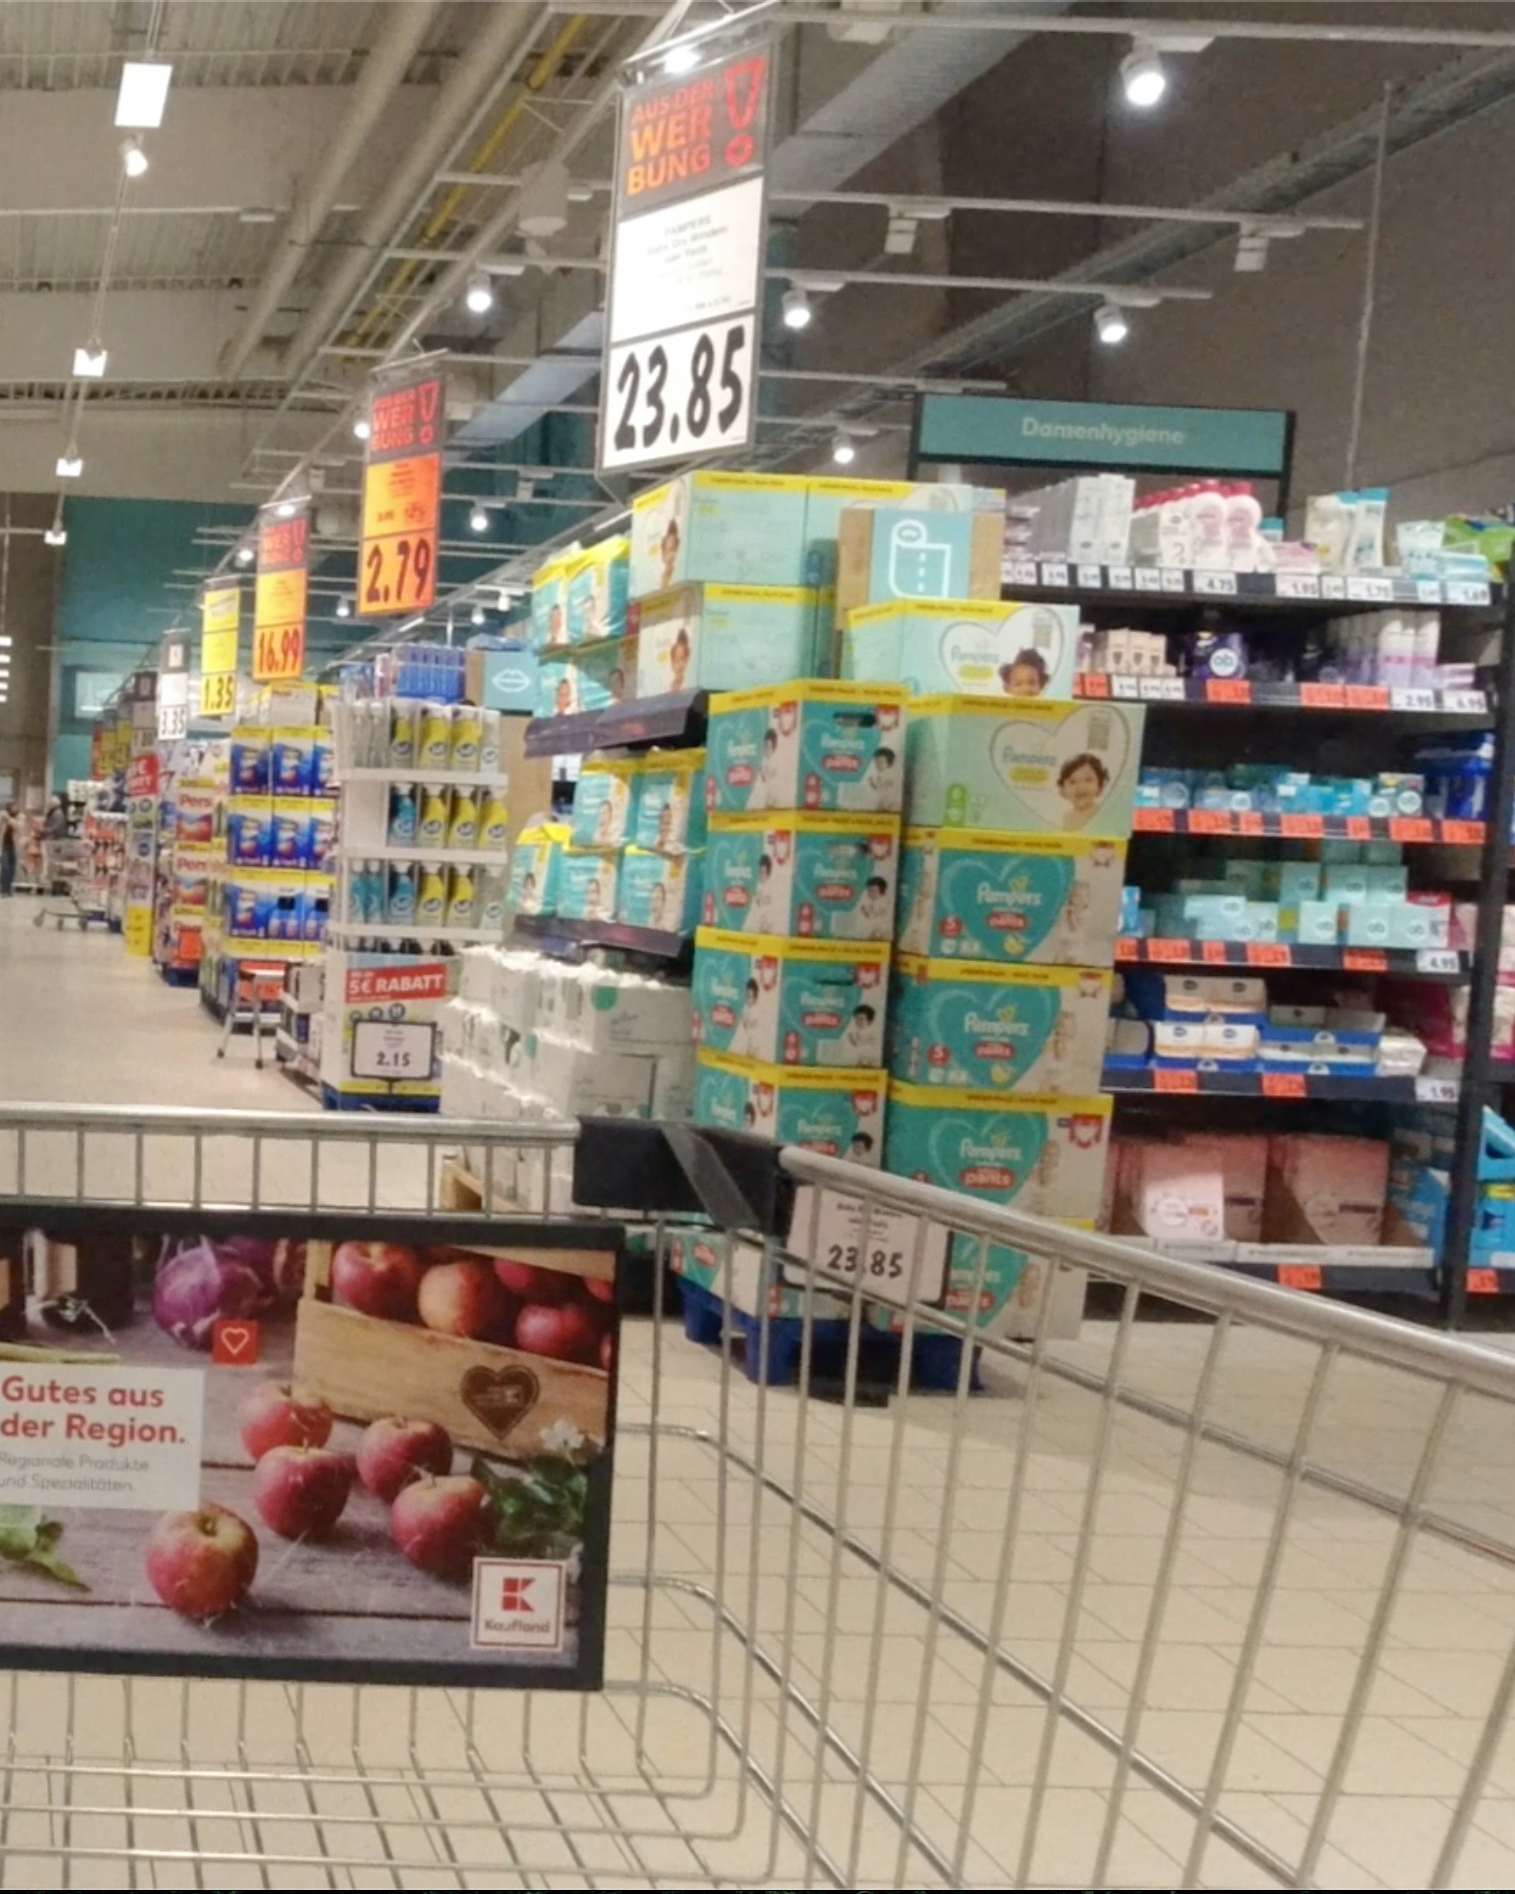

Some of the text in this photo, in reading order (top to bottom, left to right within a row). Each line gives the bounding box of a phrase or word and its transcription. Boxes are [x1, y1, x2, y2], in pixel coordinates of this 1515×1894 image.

[631, 95, 670, 126] AUS
[630, 103, 712, 162] WER
[627, 142, 711, 196] BUNG
[614, 324, 745, 452] 23.85
[1022, 416, 1185, 447] Damenhygiene
[366, 537, 431, 604] 2.79
[259, 628, 301, 674] 16.99
[205, 674, 234, 711] 1.35
[976, 881, 1042, 906] Pampers
[376, 974, 444, 993] RABATT
[964, 1011, 1030, 1036] Pampers
[376, 1050, 411, 1067] 2.15
[960, 1138, 1023, 1162] Pampers
[964, 1172, 1011, 1189] pants
[1, 1375, 165, 1408] Gutes aus
[0, 1413, 186, 1448] der Region.
[79, 1454, 150, 1473] Produkte
[485, 1619, 551, 1634] Kaufland
